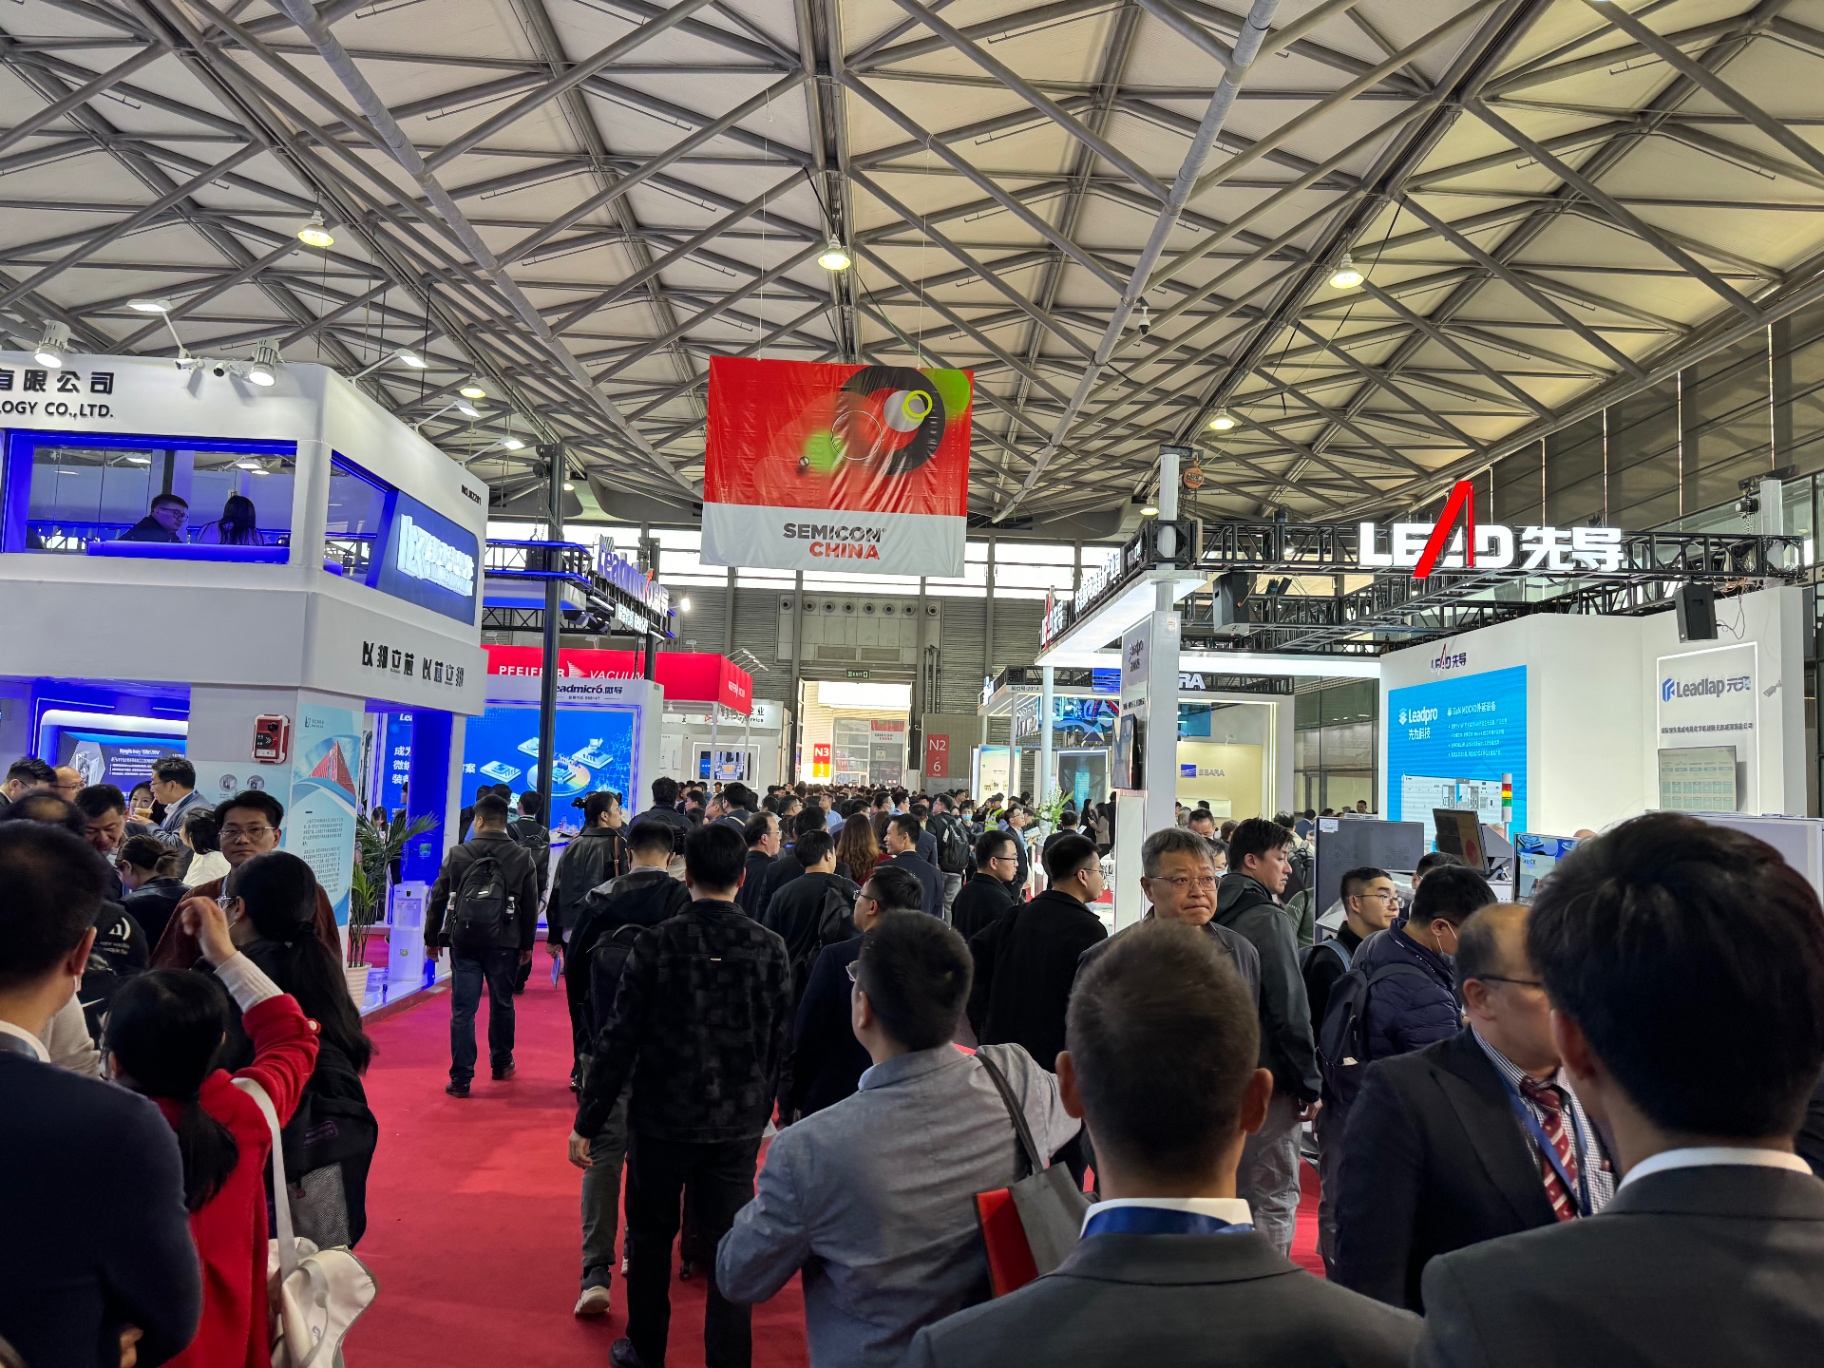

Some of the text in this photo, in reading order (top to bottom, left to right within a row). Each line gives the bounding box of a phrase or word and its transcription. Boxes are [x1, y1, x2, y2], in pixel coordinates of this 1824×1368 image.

[0, 400, 38, 415] OGY
[783, 522, 881, 543] SEMICON
[1360, 480, 1624, 579] LEAD 先导
[809, 541, 880, 560] CHINA
[1676, 678, 1725, 698] Leadlap
[1408, 706, 1438, 725] Leadpro
[814, 747, 829, 756] N3
[929, 740, 946, 751] N2
[933, 761, 941, 772] 6
